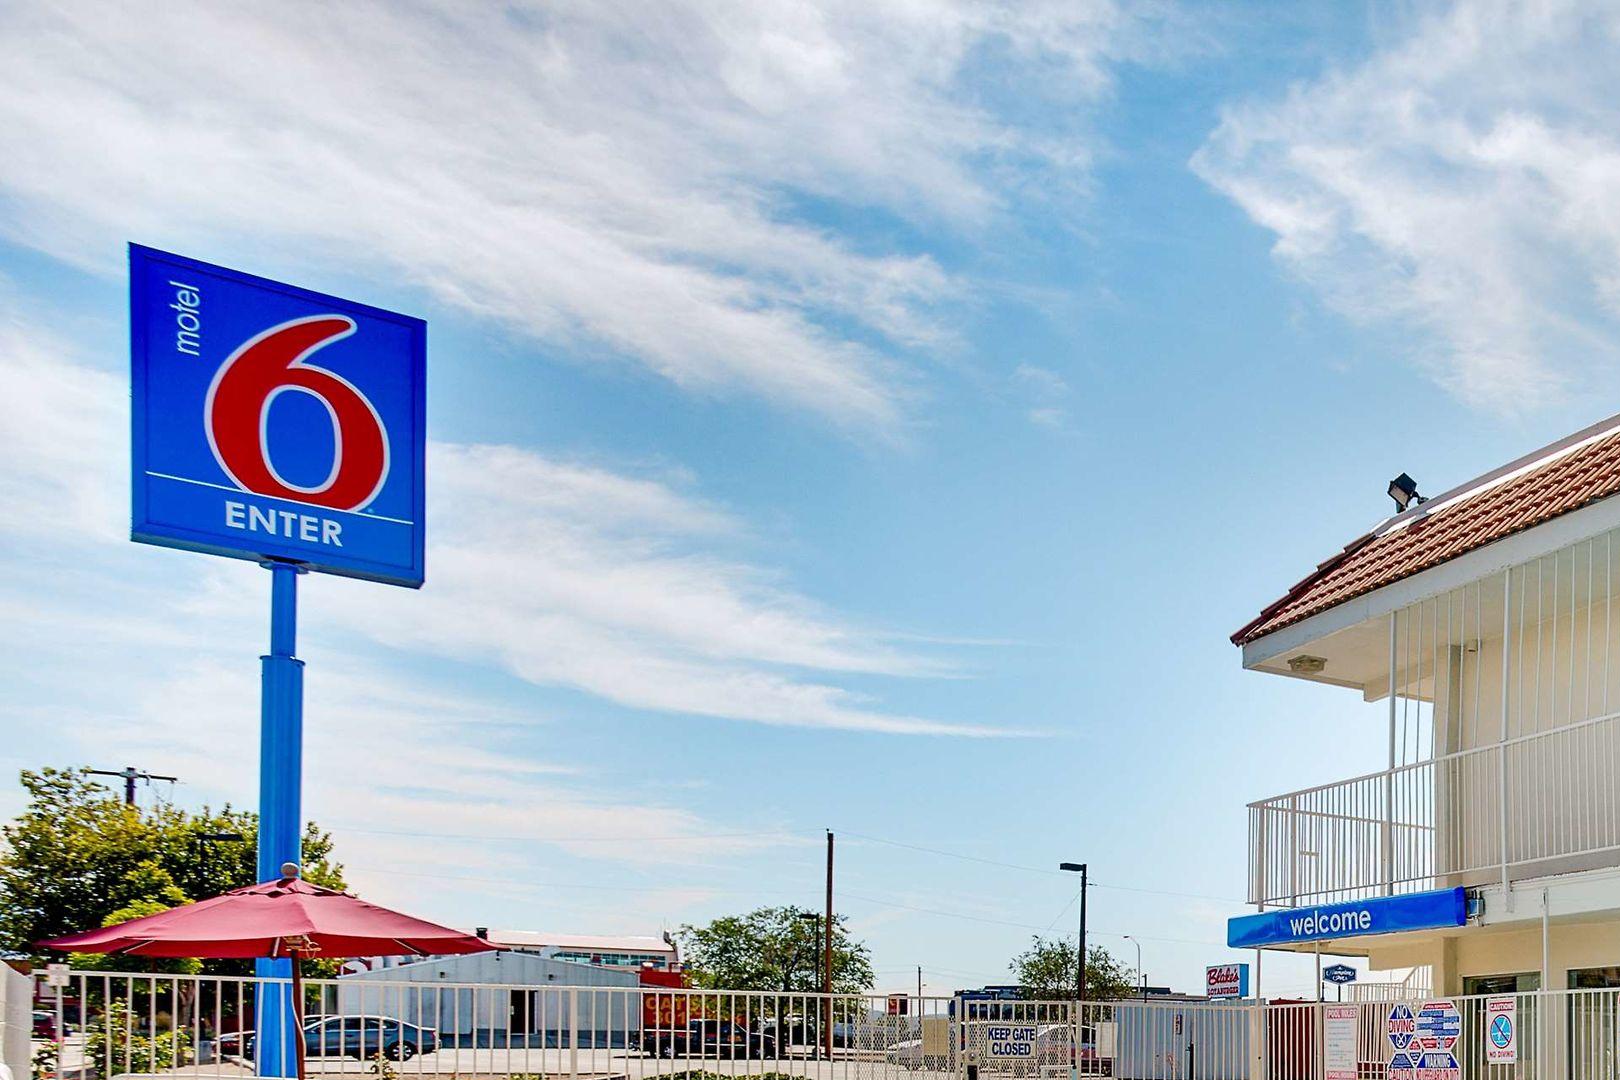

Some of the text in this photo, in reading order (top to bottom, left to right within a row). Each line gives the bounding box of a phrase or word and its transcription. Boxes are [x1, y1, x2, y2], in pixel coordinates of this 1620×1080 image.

[169, 280, 200, 356] motel
[204, 314, 390, 512] 6
[225, 501, 343, 547] ENTER
[1290, 910, 1371, 936] welcome
[1207, 968, 1239, 985] Blake's
[1396, 1005, 1408, 1019] NO
[988, 1028, 1035, 1040] KEEP GATE
[1388, 1019, 1415, 1033] DIVING
[992, 1043, 1031, 1055] CLOSED
[1424, 1053, 1450, 1068] WARNING
